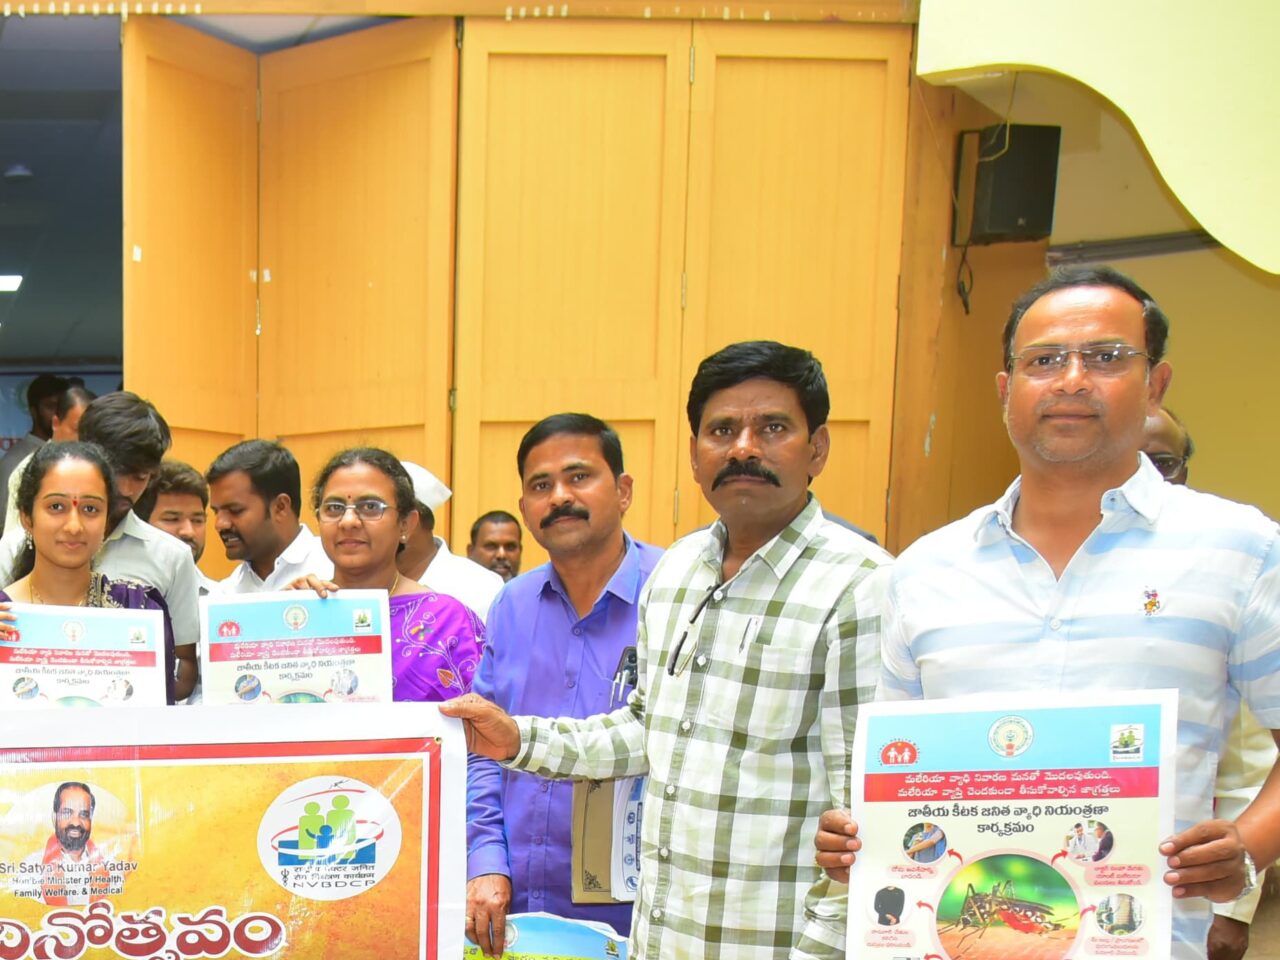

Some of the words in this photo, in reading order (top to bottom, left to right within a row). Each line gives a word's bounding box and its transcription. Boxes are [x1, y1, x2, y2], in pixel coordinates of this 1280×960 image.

[905, 774, 945, 784] మలేరియా
[950, 774, 970, 785] వ్యాధి
[974, 774, 1007, 782] నివారణ
[1011, 771, 1040, 782] మనతో
[1045, 771, 1111, 782] మొదలవుతుంది.
[908, 804, 950, 818] జాతీయ
[952, 802, 978, 817] కీటక
[981, 805, 1010, 817] జనిత
[1013, 805, 1041, 821] వ్యాధి
[1045, 804, 1109, 820] నియంత్రణా
[977, 822, 1034, 836] కార్యక్రమం
[103, 861, 137, 871] Yadav
[293, 880, 375, 888] NVBDCP
[14, 889, 42, 898] Family
